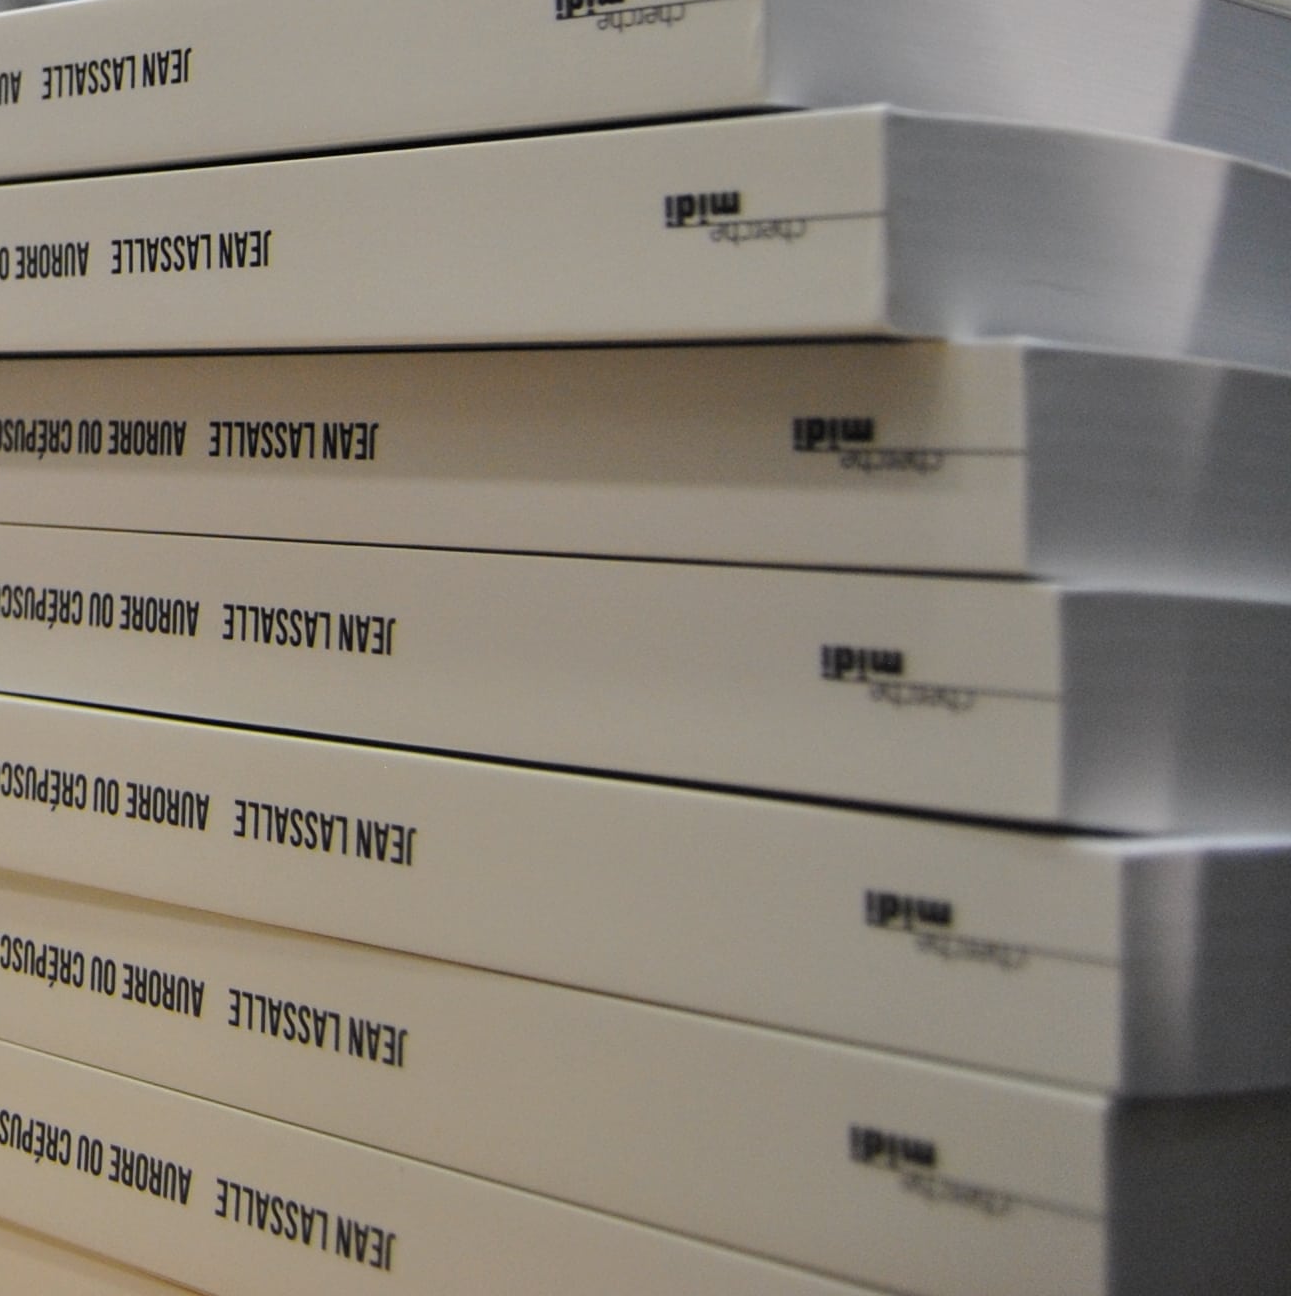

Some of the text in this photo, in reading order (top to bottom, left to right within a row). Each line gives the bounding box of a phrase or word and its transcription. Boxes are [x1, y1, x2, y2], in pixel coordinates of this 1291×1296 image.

[596, 3, 685, 32] cherche
[42, 54, 137, 101] LASSALLE
[142, 47, 192, 88] JEAN
[665, 190, 740, 228] midi
[15, 241, 90, 280] AURORE
[110, 233, 211, 275] LASSALLE
[219, 229, 272, 269] JEAN
[78, 418, 103, 455] OU
[107, 419, 187, 457] AURORE
[208, 421, 316, 459] LASSALLE
[322, 422, 379, 461] JEAN
[793, 418, 874, 451] midi
[89, 592, 114, 629] OU
[119, 594, 200, 637] AURORE
[222, 603, 331, 650] LASSALLE
[338, 613, 396, 656] JEAN
[821, 644, 904, 682] midi
[93, 776, 120, 816] OU
[125, 781, 210, 832] AURORE
[233, 799, 348, 856] LASSALLE
[356, 818, 417, 867] JEAN
[866, 890, 952, 930] midi
[90, 955, 117, 996] OU
[121, 963, 205, 1018] AURORE
[228, 988, 341, 1053] LASSALLE
[348, 1016, 408, 1068] JEAN
[77, 1134, 103, 1177] OU
[108, 1144, 193, 1206] AURORE
[214, 1177, 329, 1252] LASSALLE
[335, 1215, 396, 1272] JEAN
